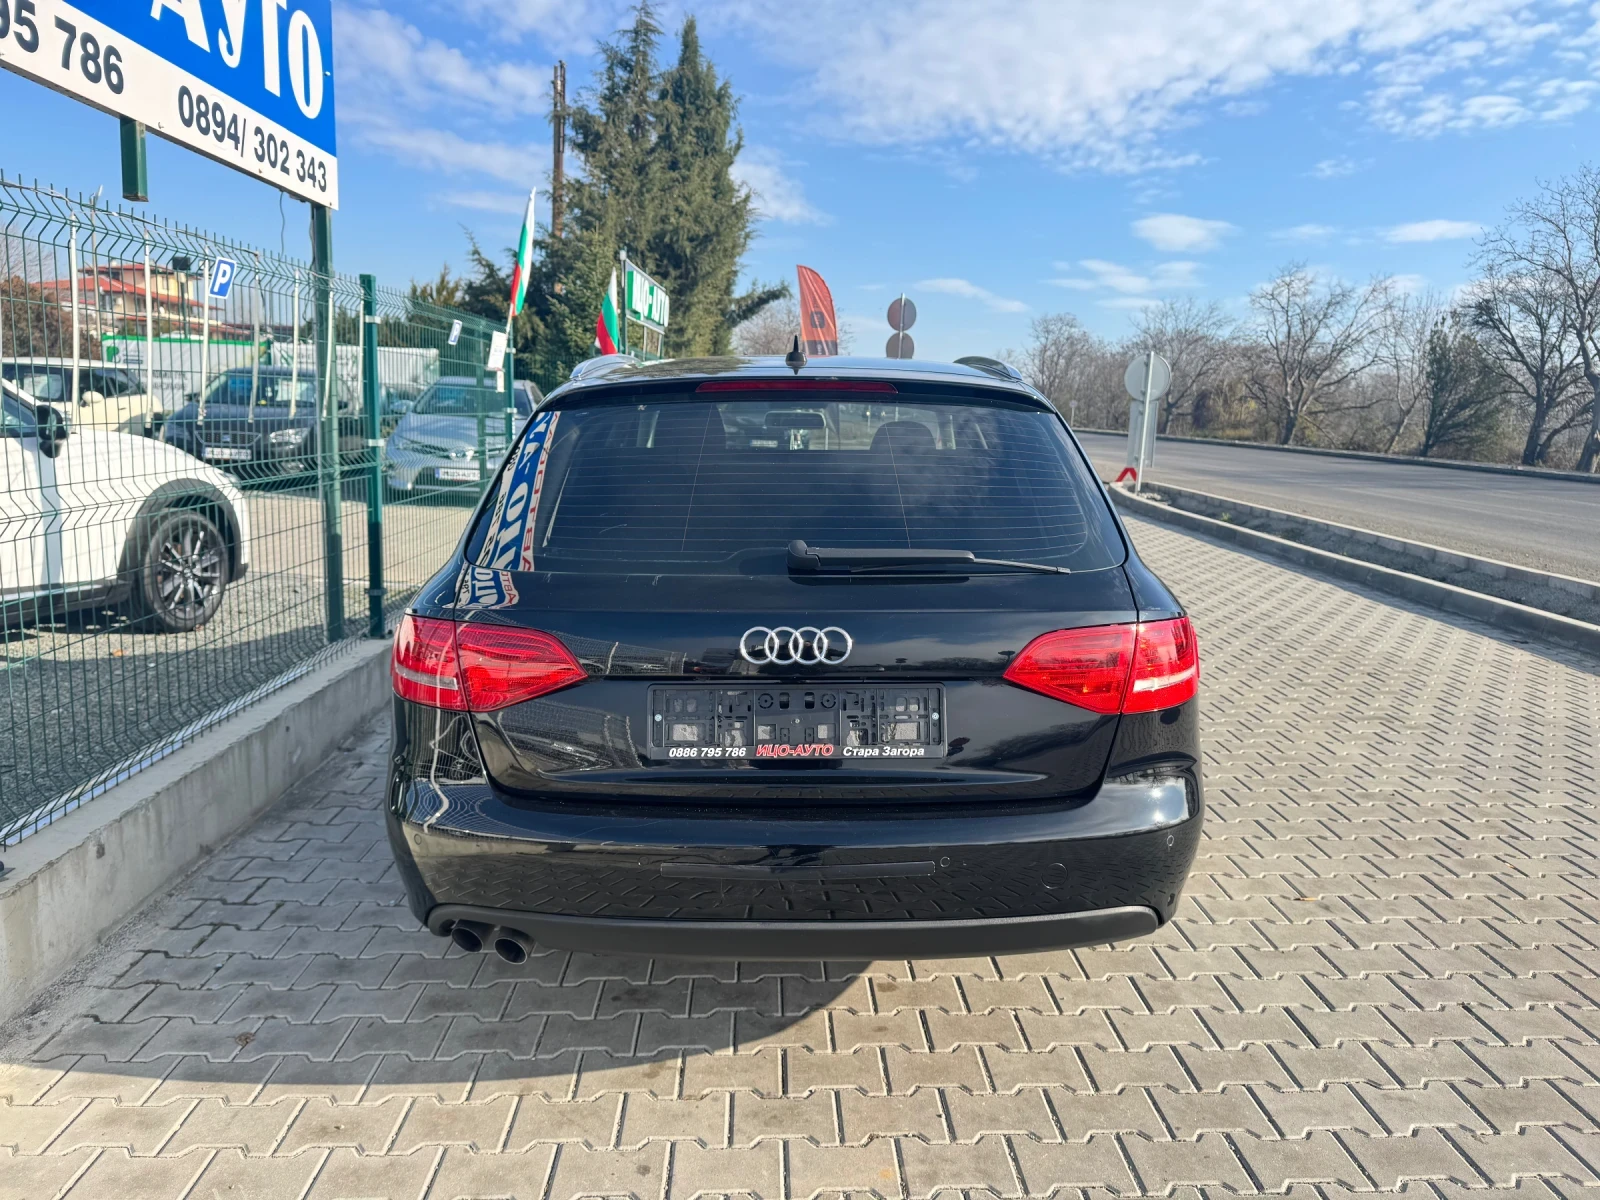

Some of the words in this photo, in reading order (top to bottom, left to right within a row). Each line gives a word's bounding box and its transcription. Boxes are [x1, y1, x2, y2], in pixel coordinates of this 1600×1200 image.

[54, 15, 124, 94] 786
[253, 126, 290, 176] 302
[296, 149, 327, 193] 343
[668, 747, 698, 758] 0886
[700, 747, 722, 758] 795
[725, 747, 747, 758] 786
[756, 743, 834, 759] ИЦО-АУТО
[842, 746, 879, 758] Стара
[881, 745, 925, 758] Загора
